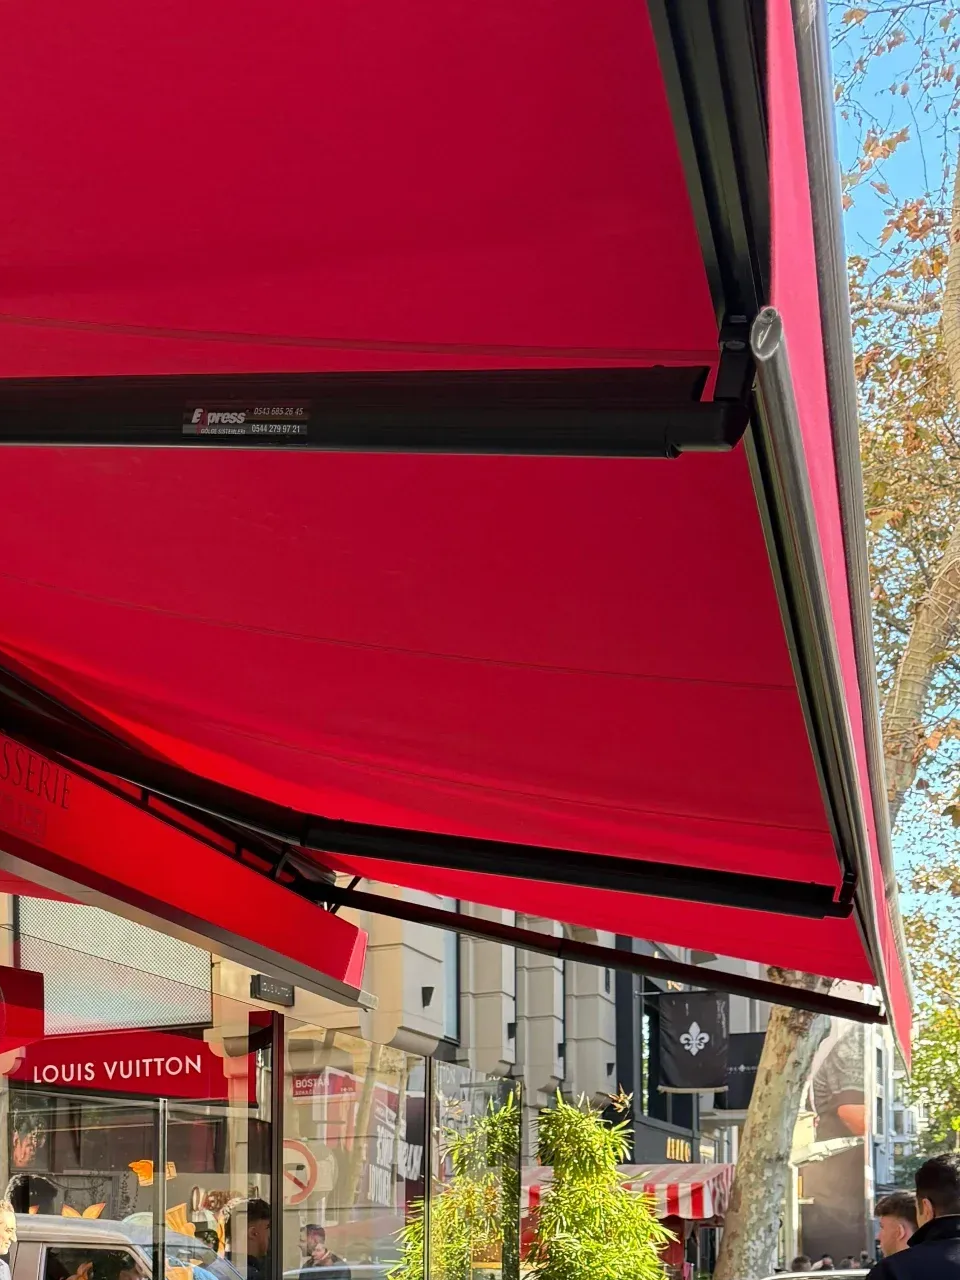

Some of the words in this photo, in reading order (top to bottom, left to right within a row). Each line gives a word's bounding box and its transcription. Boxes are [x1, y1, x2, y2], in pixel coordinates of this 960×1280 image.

[251, 424, 268, 433] 0544
[268, 424, 281, 433] 279
[282, 424, 291, 433] 97
[292, 424, 300, 433] 21
[33, 1062, 96, 1084] LOUIS
[103, 1054, 202, 1080] VUITTON
